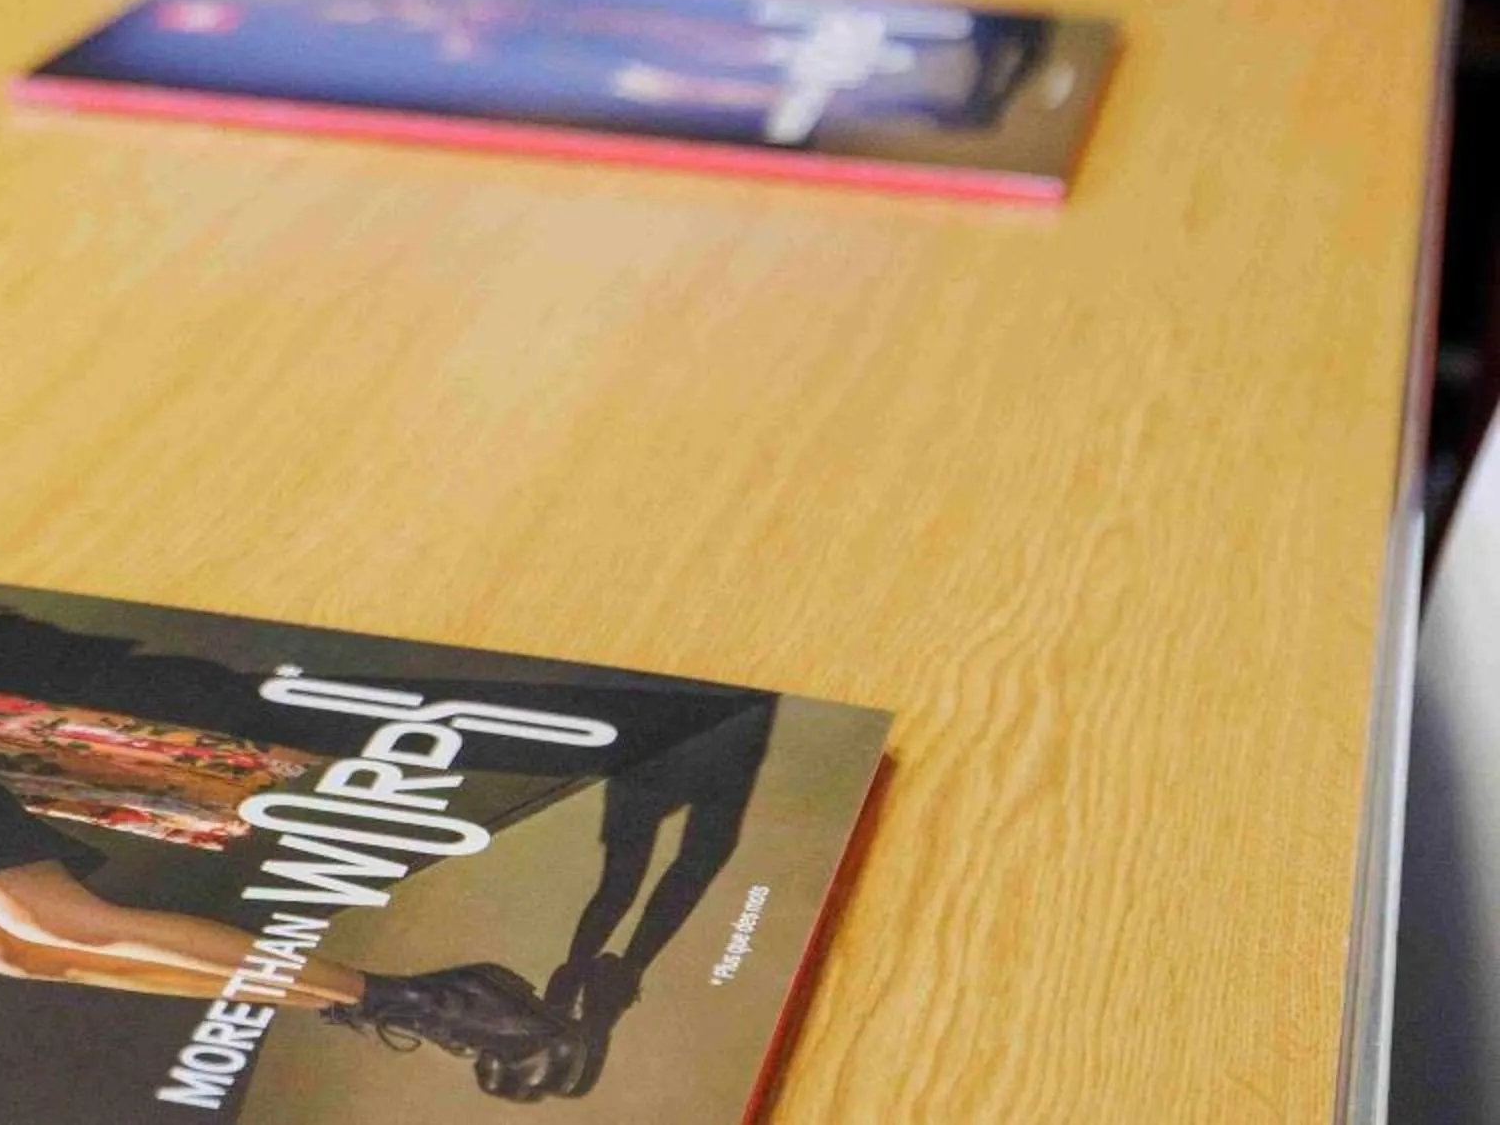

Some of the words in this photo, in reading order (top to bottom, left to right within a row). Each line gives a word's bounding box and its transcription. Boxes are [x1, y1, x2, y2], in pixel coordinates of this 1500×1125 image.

[744, 884, 771, 912] mots
[730, 911, 761, 933] des
[725, 931, 754, 954] que
[156, 999, 276, 1110] MORE
[221, 911, 331, 1001] THAN
